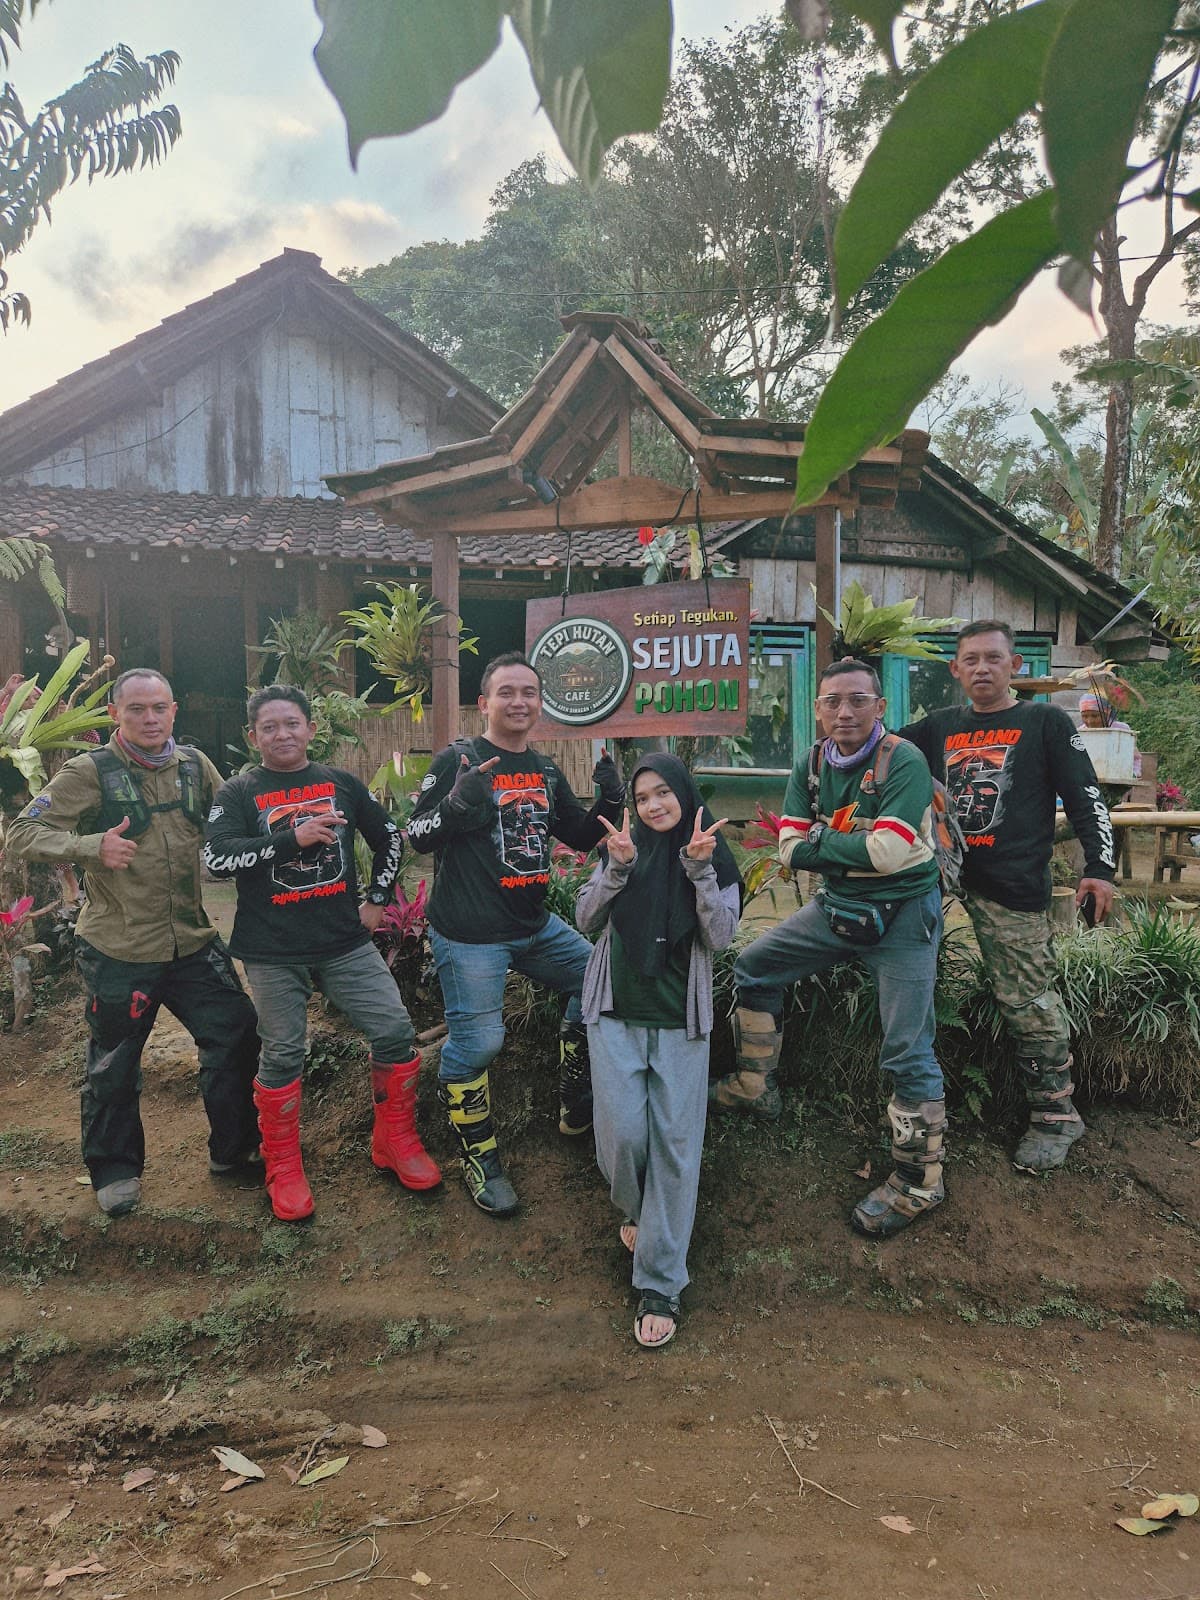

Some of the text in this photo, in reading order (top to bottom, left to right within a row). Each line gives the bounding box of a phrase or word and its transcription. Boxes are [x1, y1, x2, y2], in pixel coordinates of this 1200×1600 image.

[633, 608, 738, 628] Setiap Tegukan,
[540, 625, 616, 659] TEPI HUTAN
[632, 633, 742, 676] SEJUTA
[564, 689, 591, 702] CAFÉ
[634, 679, 739, 714] POHON
[945, 729, 1022, 751] VOLCANO
[255, 781, 336, 811] VOLCANO
